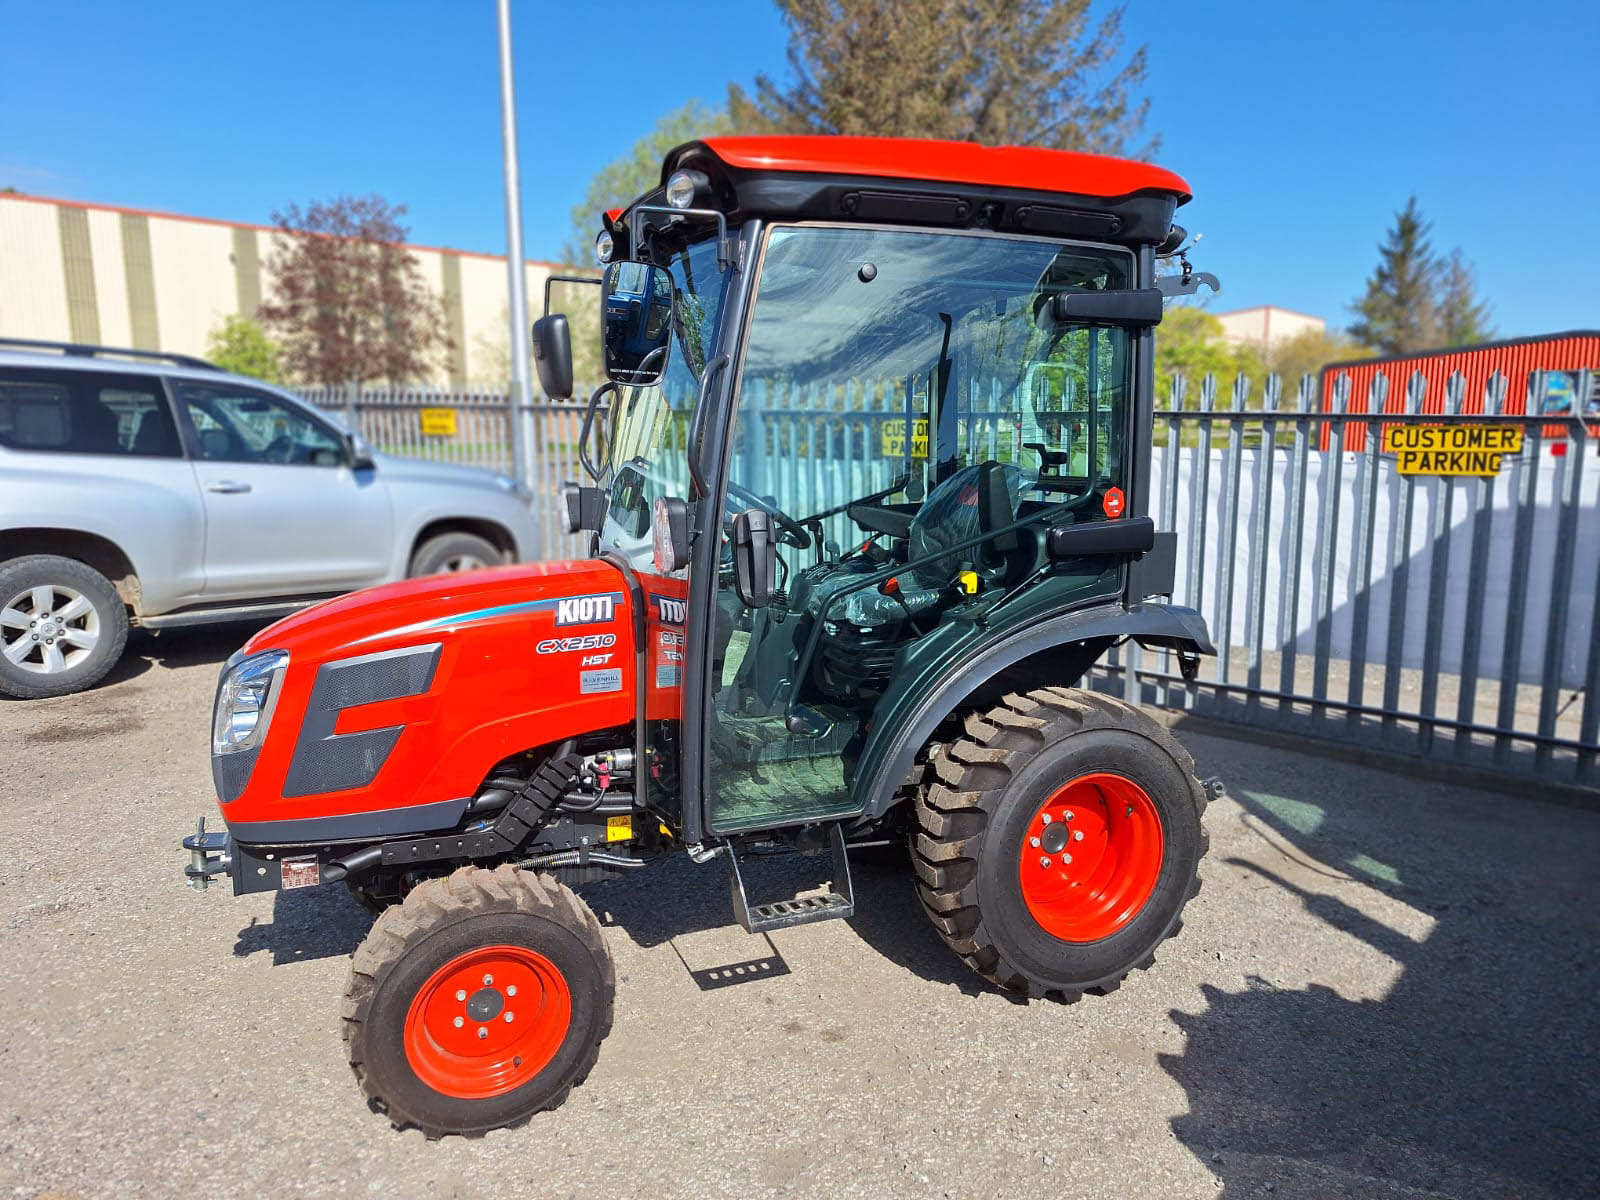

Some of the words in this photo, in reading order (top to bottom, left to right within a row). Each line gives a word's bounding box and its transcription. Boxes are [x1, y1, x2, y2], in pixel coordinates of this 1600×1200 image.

[1391, 428, 1516, 448] CUSTOMER
[1403, 452, 1502, 472] PARKING
[558, 595, 612, 624] KIOTI
[536, 633, 616, 655] CX2510
[581, 653, 614, 667] HST
